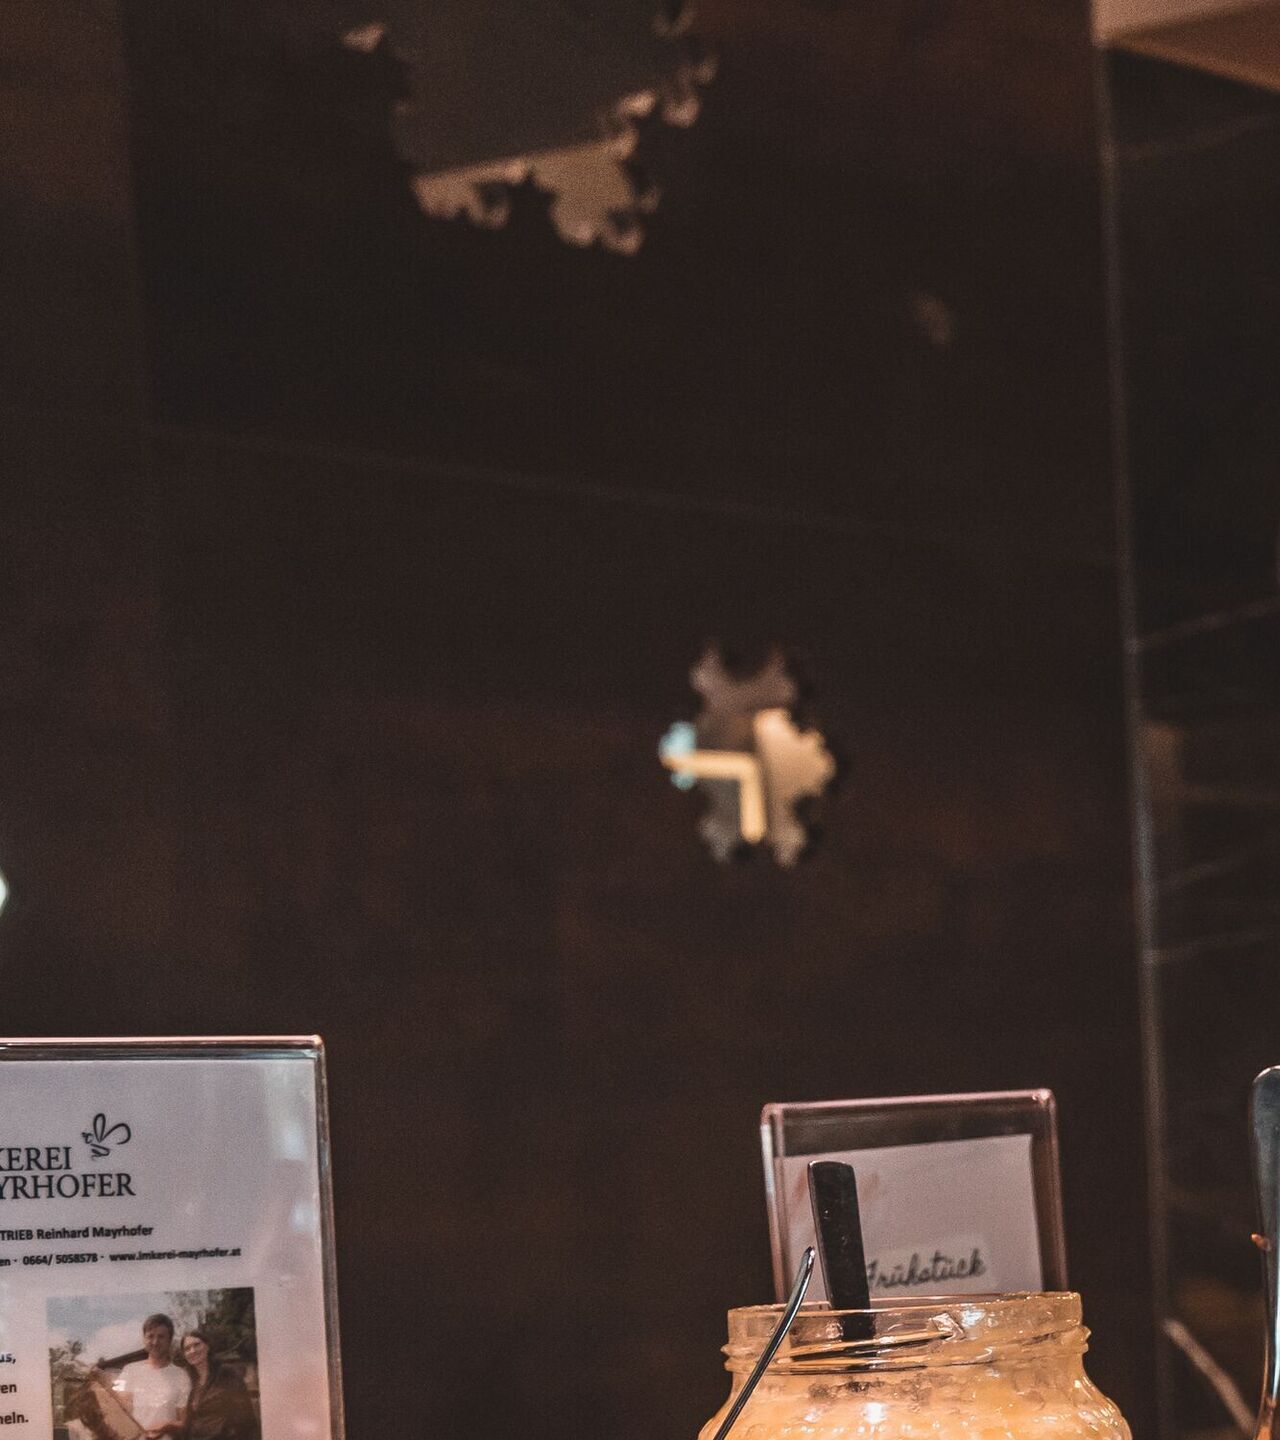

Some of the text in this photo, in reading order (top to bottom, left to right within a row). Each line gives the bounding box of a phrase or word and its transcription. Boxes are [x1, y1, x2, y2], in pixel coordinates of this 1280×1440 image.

[37, 1227, 89, 1239] Reinhard
[92, 1225, 154, 1238] Mayrhofer
[22, 1255, 53, 1266] 0664/
[55, 1253, 98, 1264] 5058578
